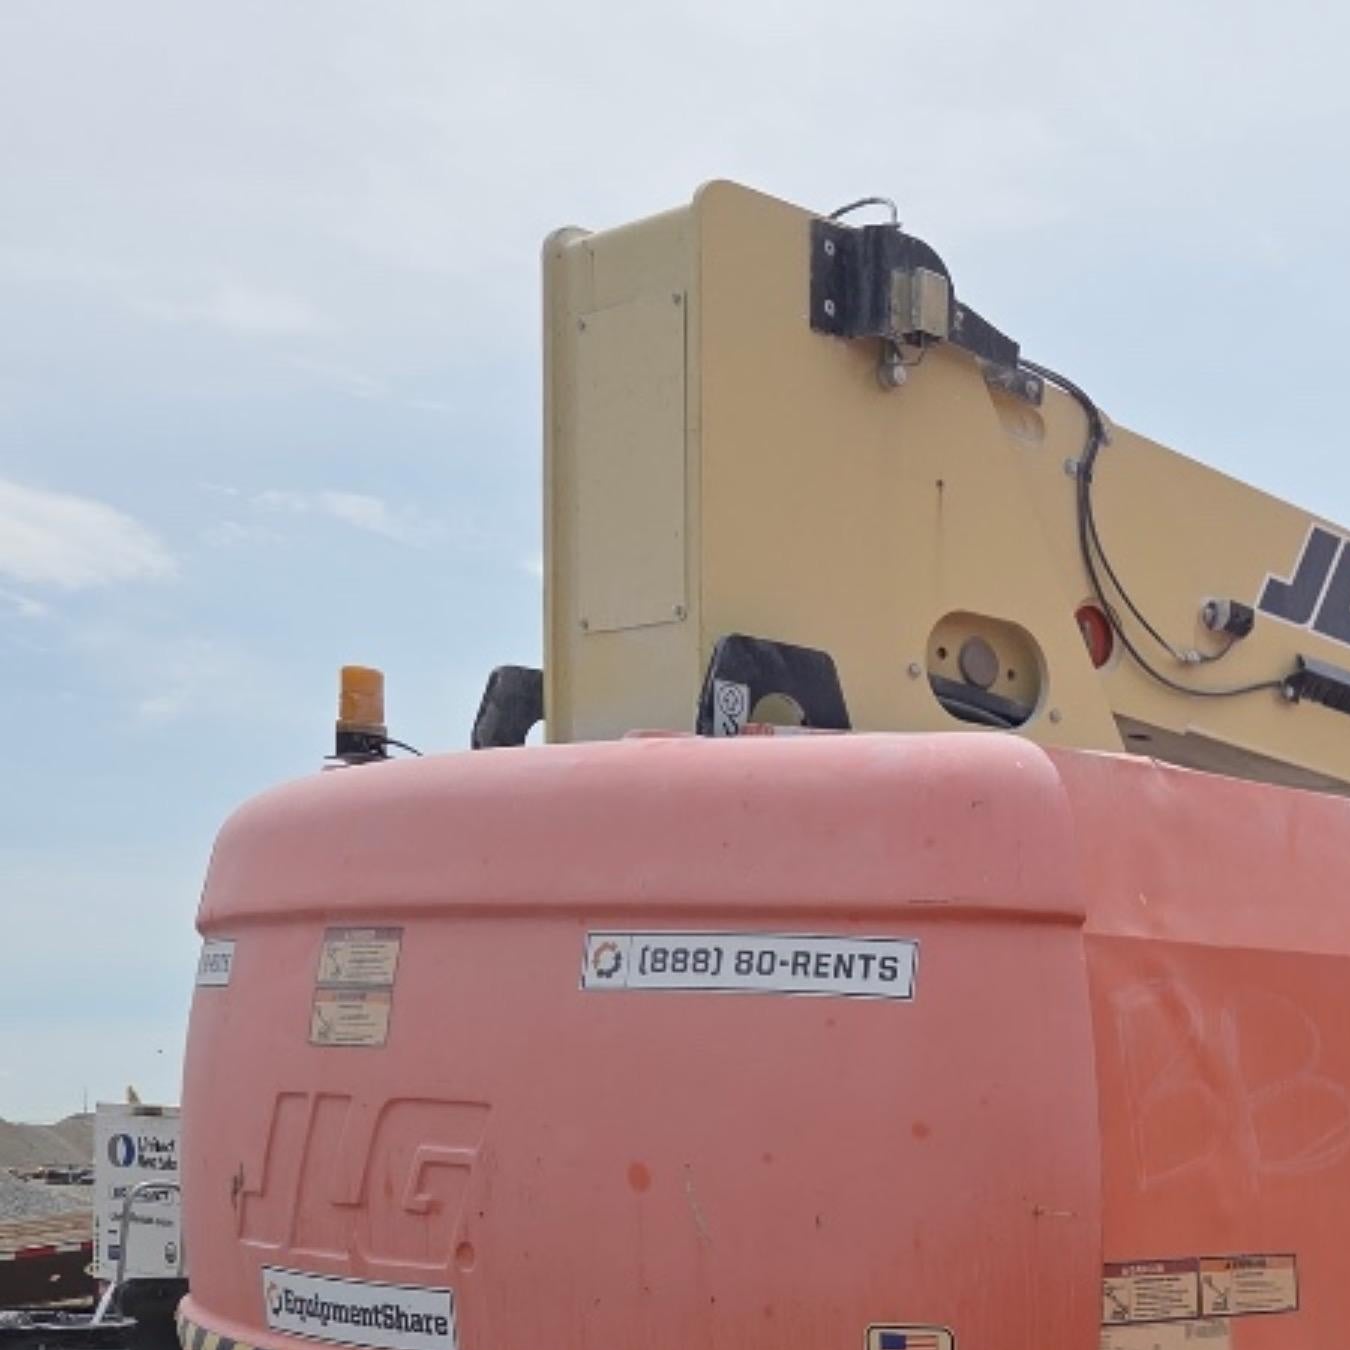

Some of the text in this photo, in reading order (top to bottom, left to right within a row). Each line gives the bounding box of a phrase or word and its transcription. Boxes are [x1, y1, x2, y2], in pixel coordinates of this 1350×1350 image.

[638, 945, 899, 982] (888) 80-RENTS
[238, 1091, 492, 1269] JLG
[284, 1288, 448, 1336] EquipmentShare
